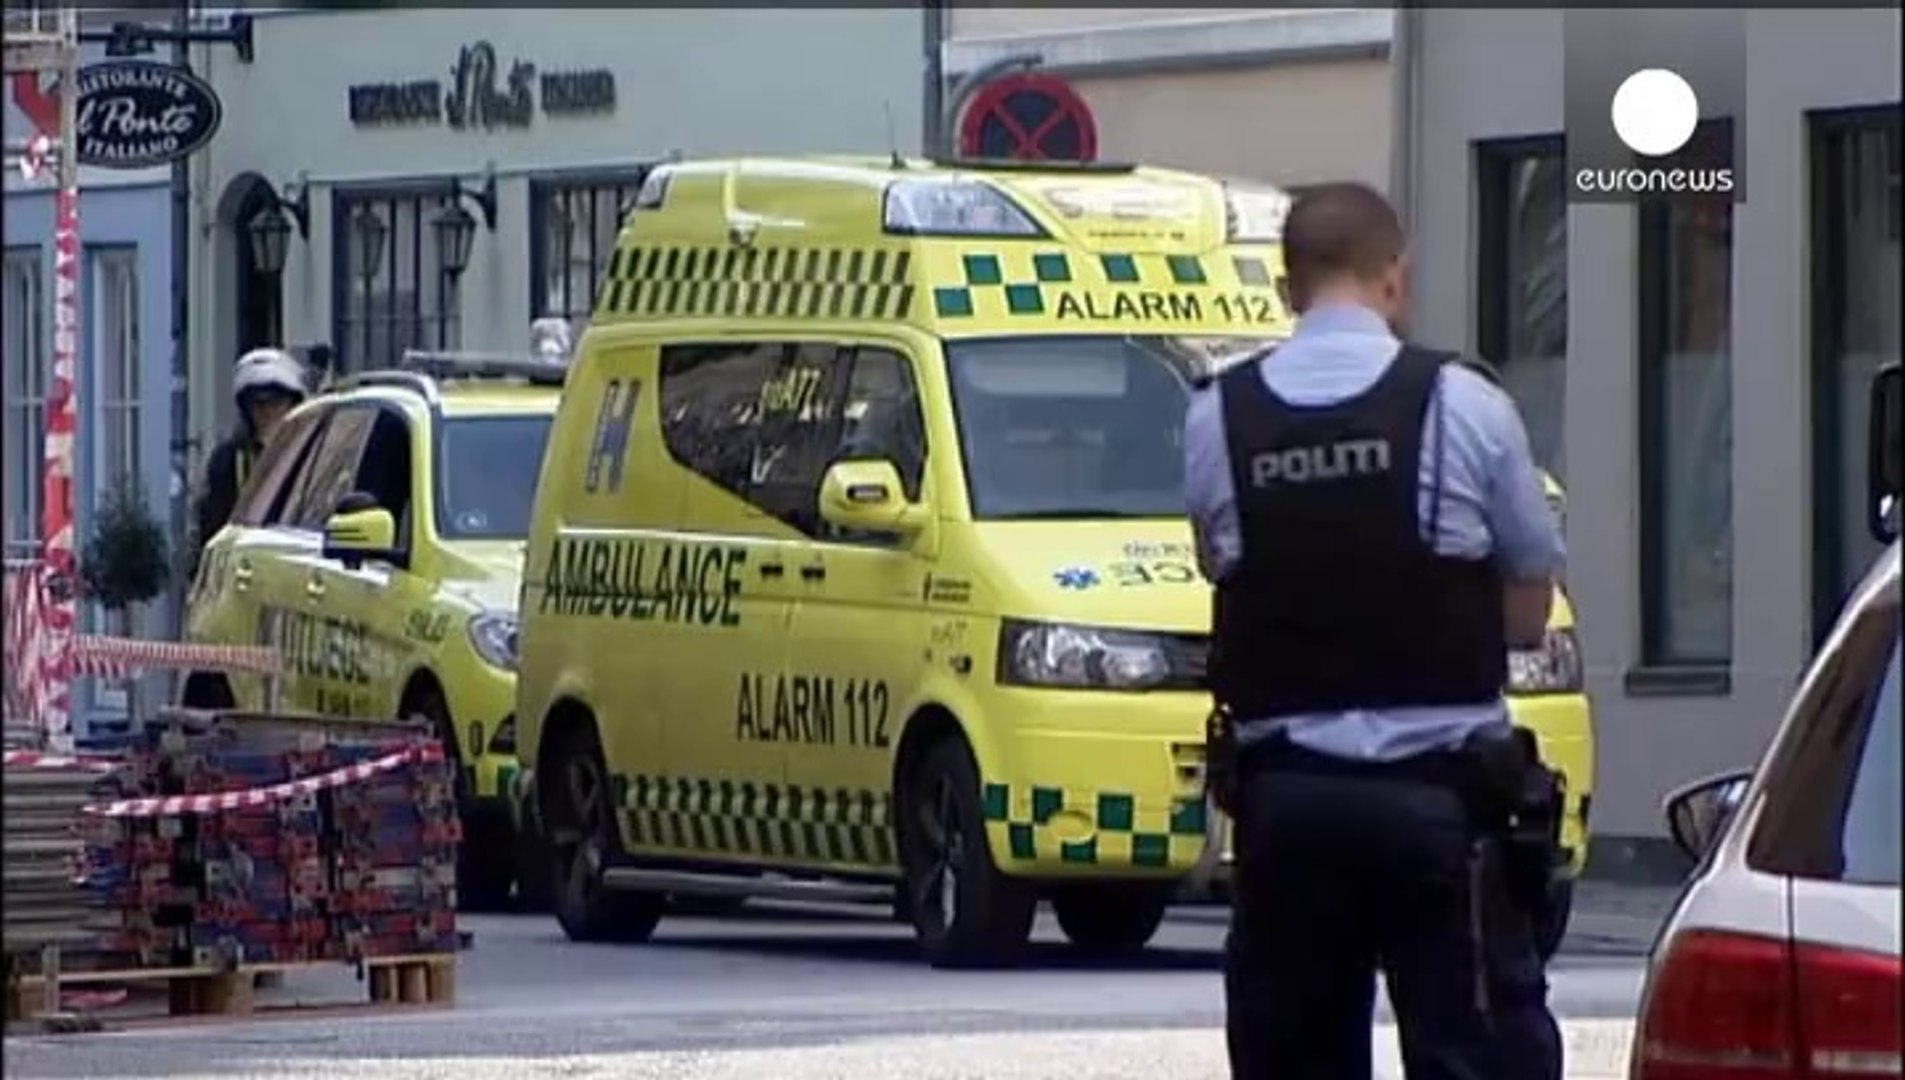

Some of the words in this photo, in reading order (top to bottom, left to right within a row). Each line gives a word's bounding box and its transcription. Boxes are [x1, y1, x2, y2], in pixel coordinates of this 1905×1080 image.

[82, 70, 188, 98] ISTORANTE
[98, 97, 197, 135] Ponte
[85, 135, 178, 158] ITALIANO
[1057, 291, 1203, 321] ALARM
[1213, 294, 1276, 323] 112
[1252, 439, 1390, 488] POLITI
[540, 539, 746, 626] AMBULANCE
[737, 672, 835, 745] ALARM
[844, 677, 889, 748] 112
